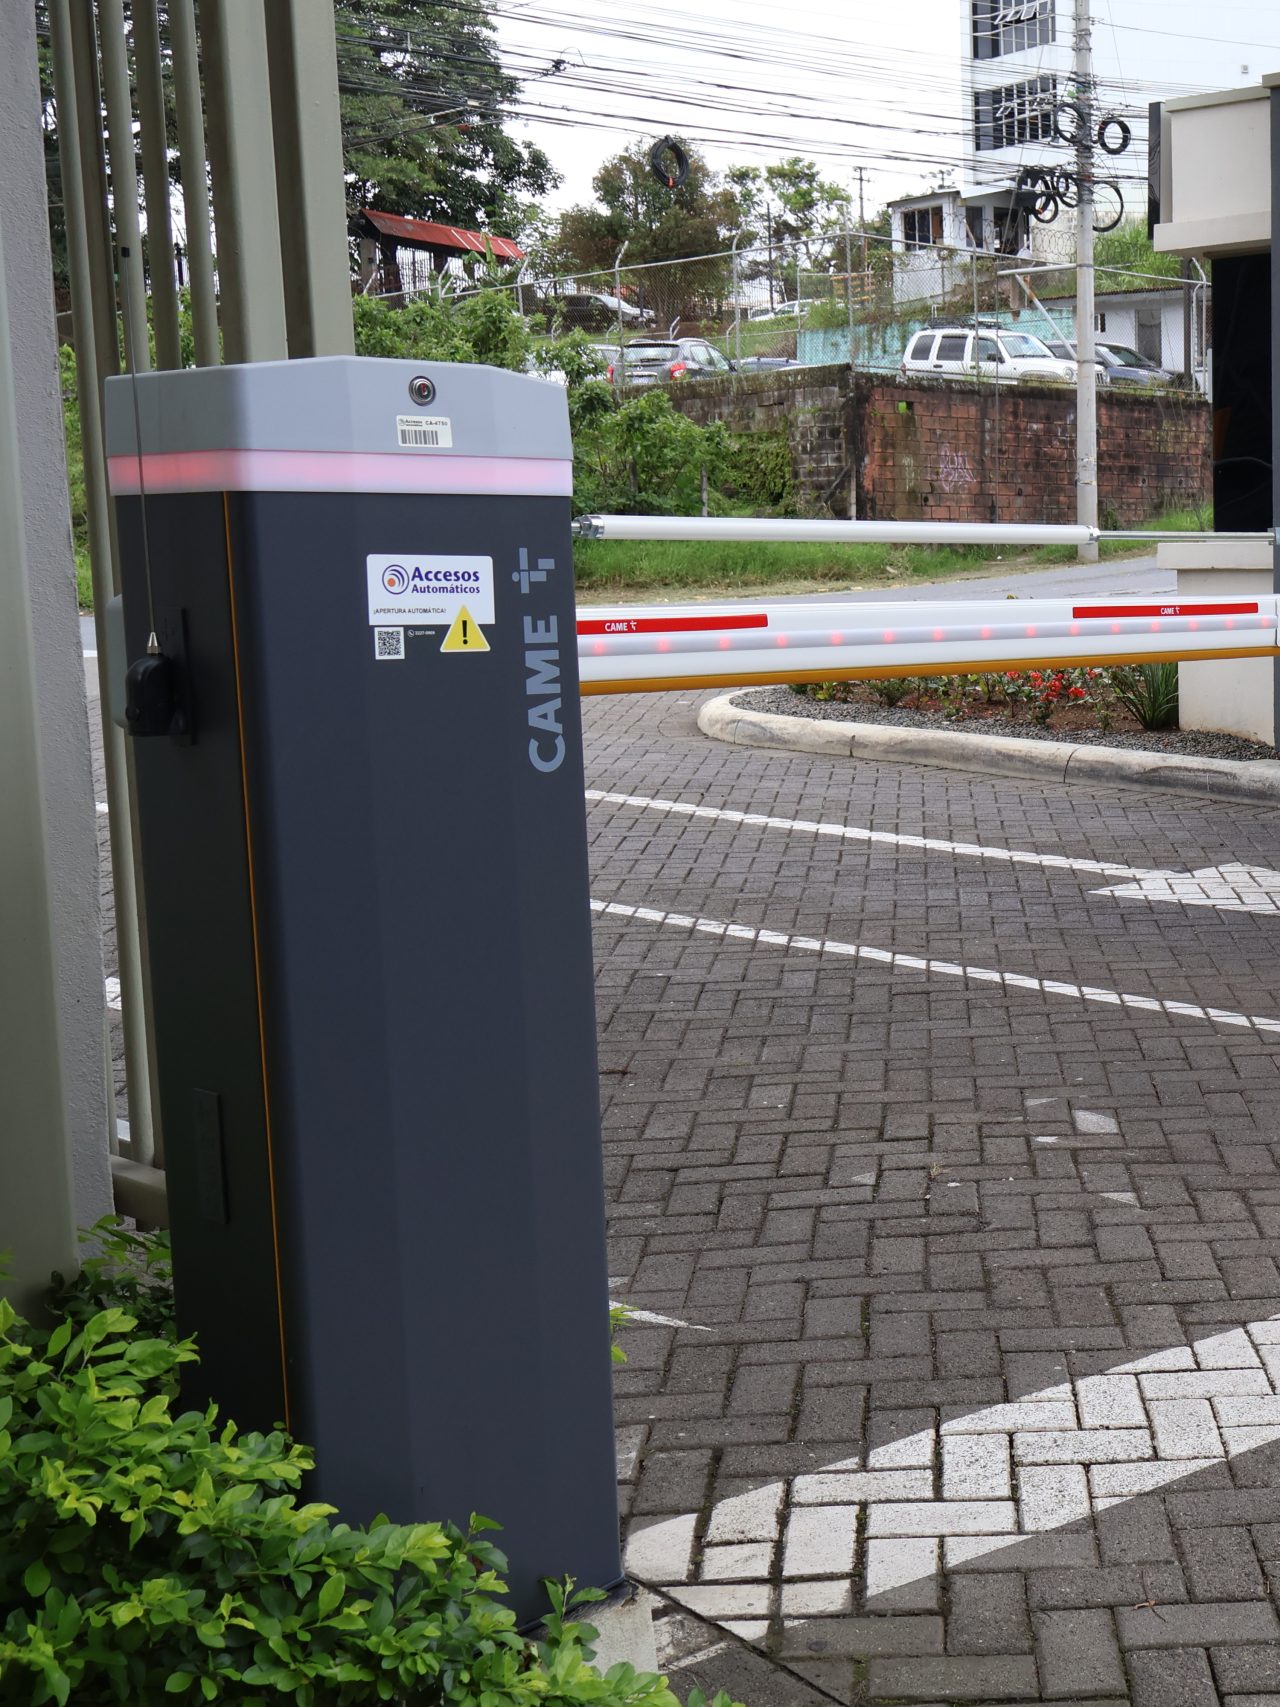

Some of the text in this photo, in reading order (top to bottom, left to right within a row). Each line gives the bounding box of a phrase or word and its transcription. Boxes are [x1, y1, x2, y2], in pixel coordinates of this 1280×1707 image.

[411, 566, 480, 582] Accesos
[411, 583, 480, 594] Automáticos
[605, 622, 628, 632] CAME
[523, 615, 566, 773] CAME
